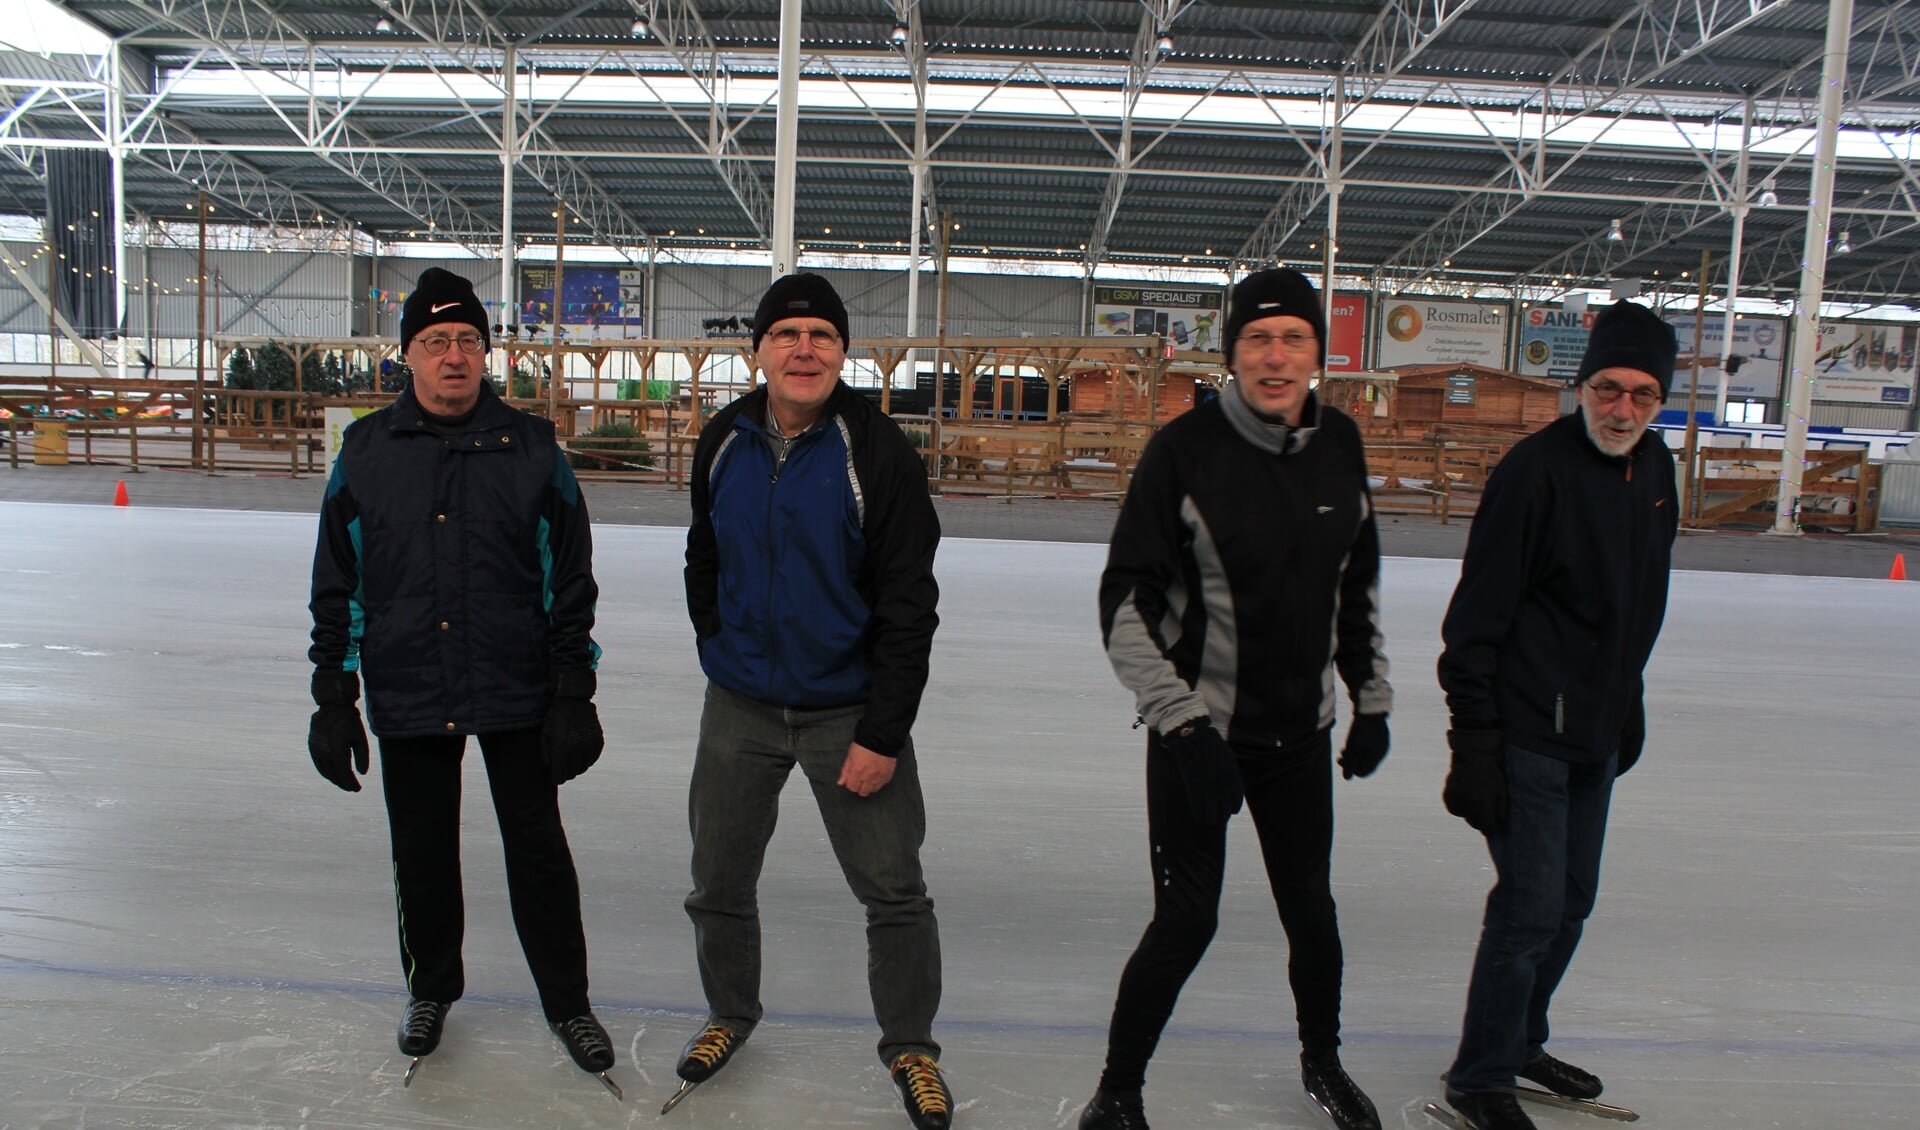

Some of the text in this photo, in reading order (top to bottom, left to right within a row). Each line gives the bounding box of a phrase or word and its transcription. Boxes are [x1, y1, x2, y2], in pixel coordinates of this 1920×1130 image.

[778, 262, 784, 273] 3
[1113, 290, 1202, 303] GSM SPECIALIST
[1332, 305, 1355, 317] en?
[1426, 307, 1500, 325] Rosmalen
[1528, 310, 1597, 329] SANI-D
